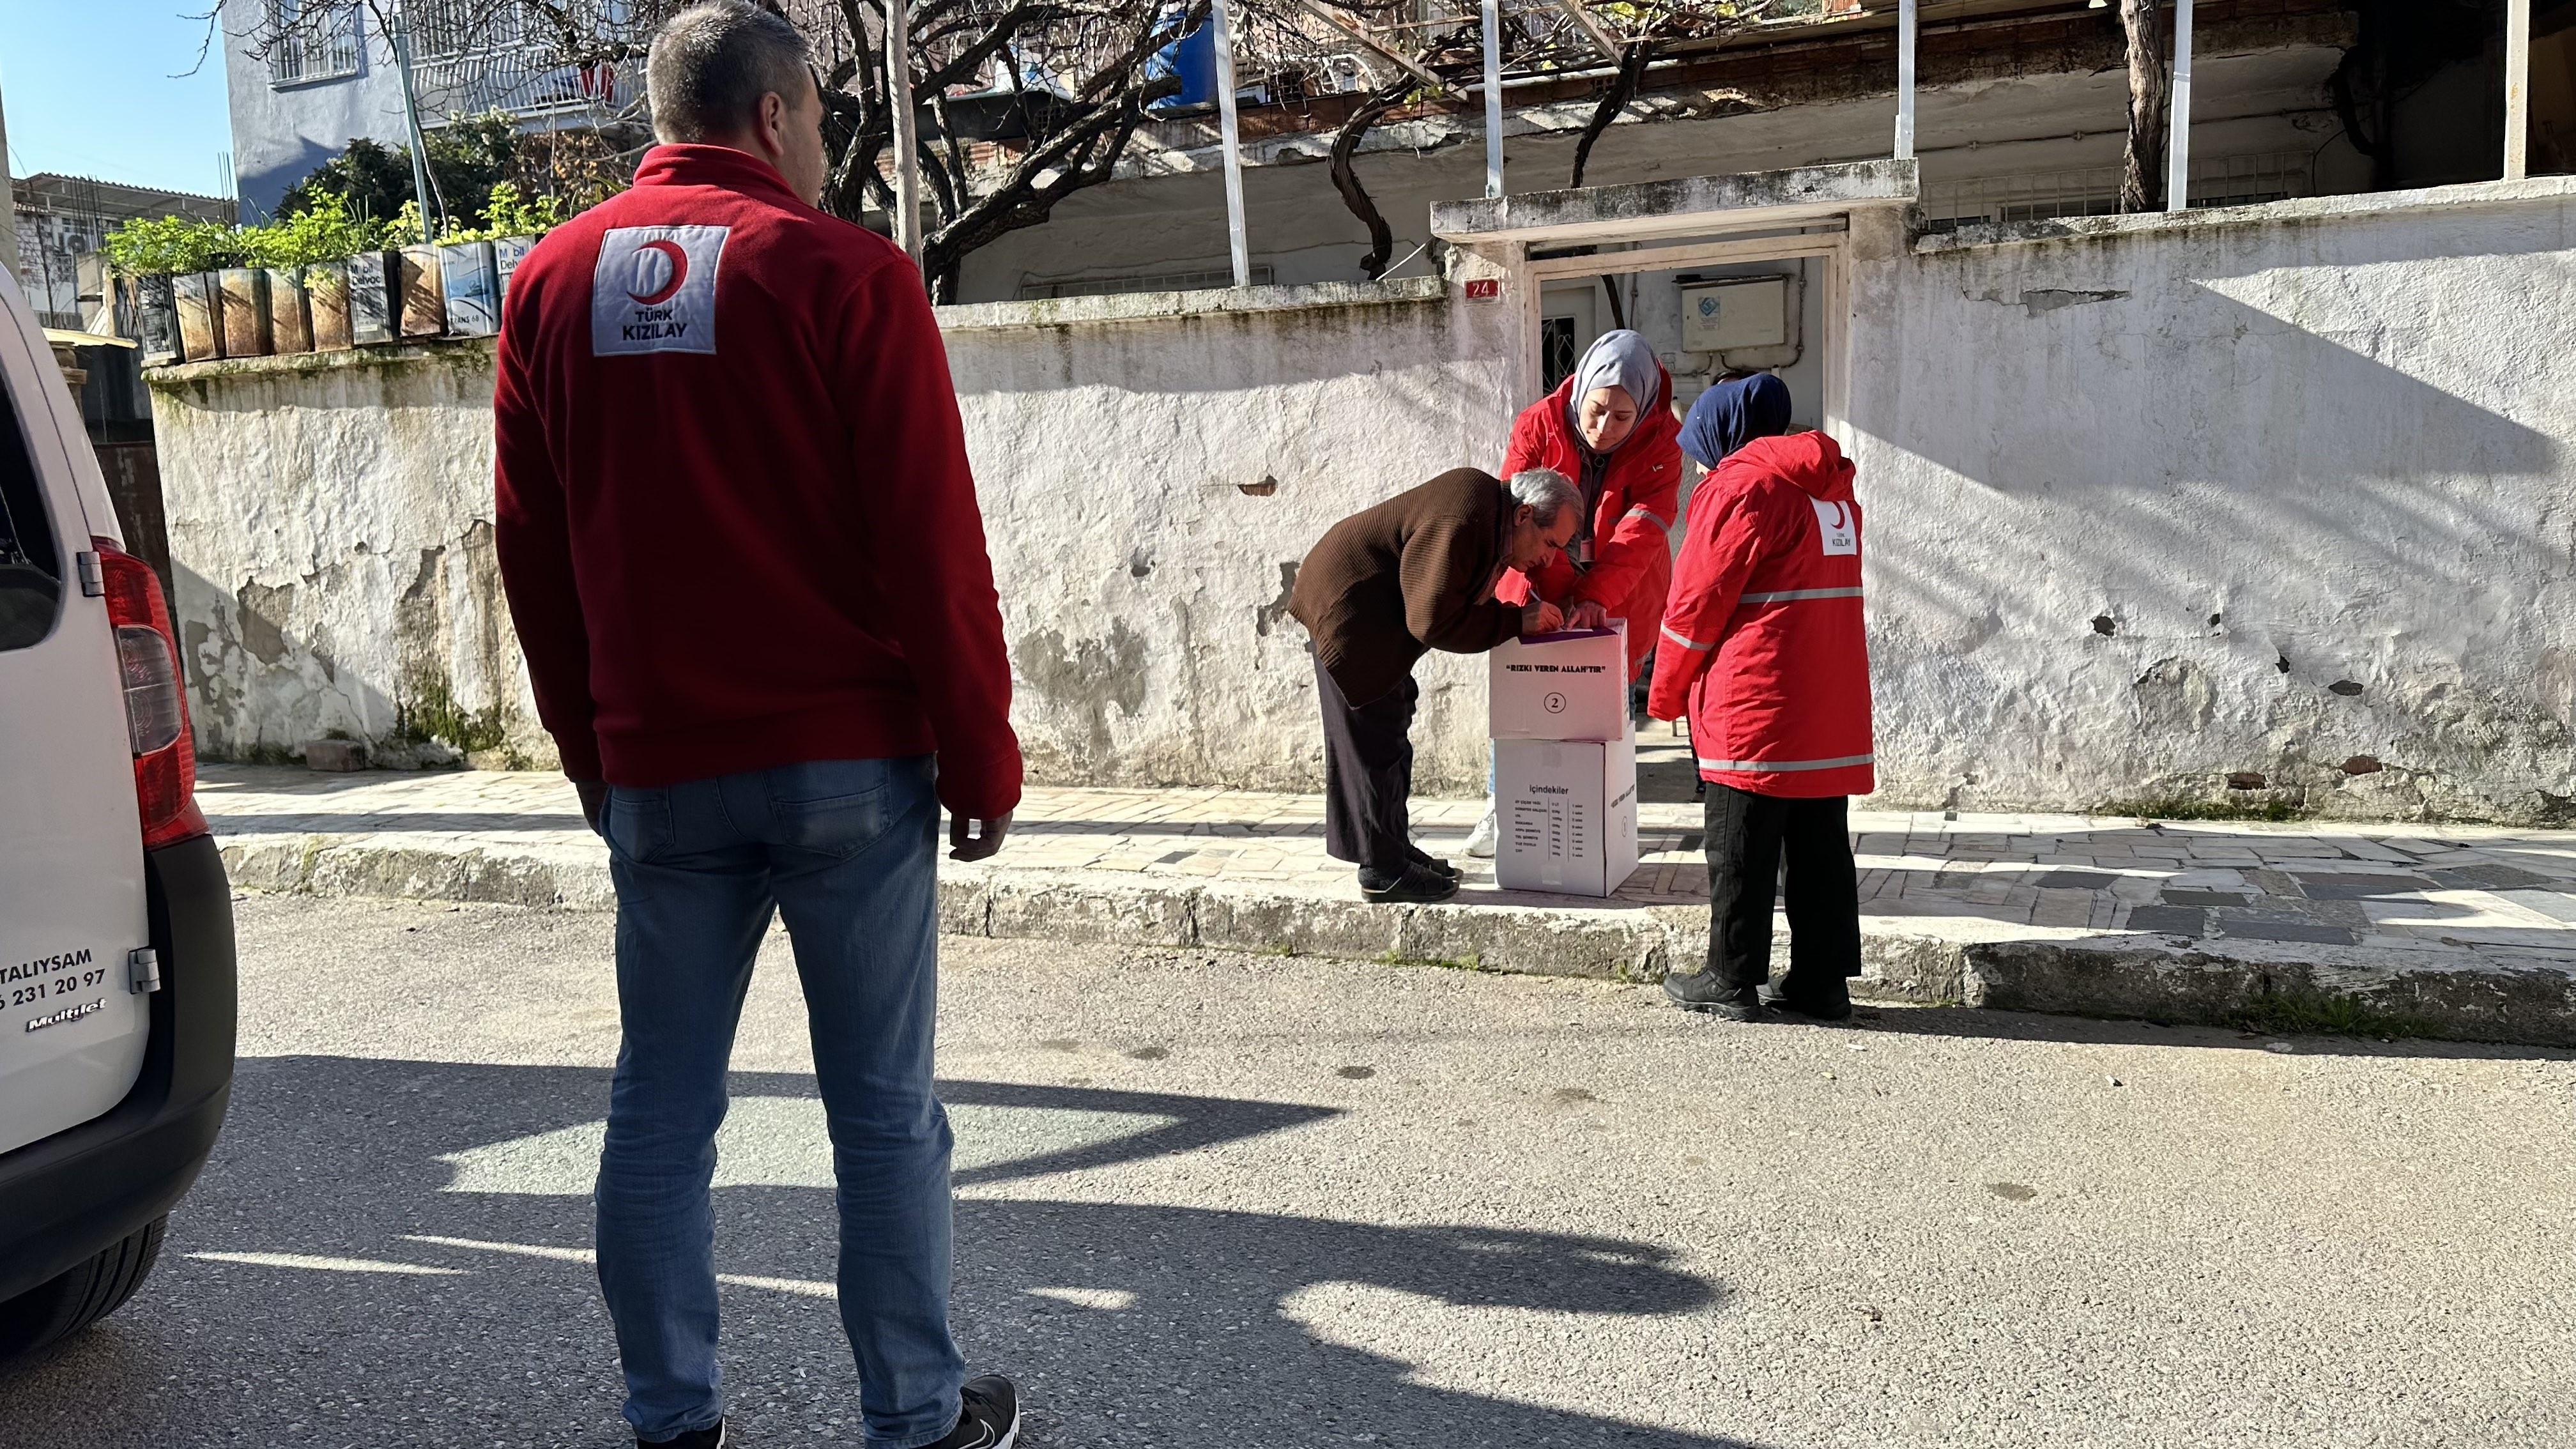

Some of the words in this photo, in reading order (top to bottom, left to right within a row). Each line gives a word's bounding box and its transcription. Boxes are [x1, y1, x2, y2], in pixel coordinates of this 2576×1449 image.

[1473, 282, 1489, 297] 24
[635, 307, 673, 322] TÜRK
[623, 323, 687, 341] KIZILAY
[1832, 538, 1851, 546] KIZILAY
[1551, 698, 1558, 708] 2
[13, 984, 45, 1006] 231
[55, 976, 77, 995] 20
[84, 968, 105, 987] 97
